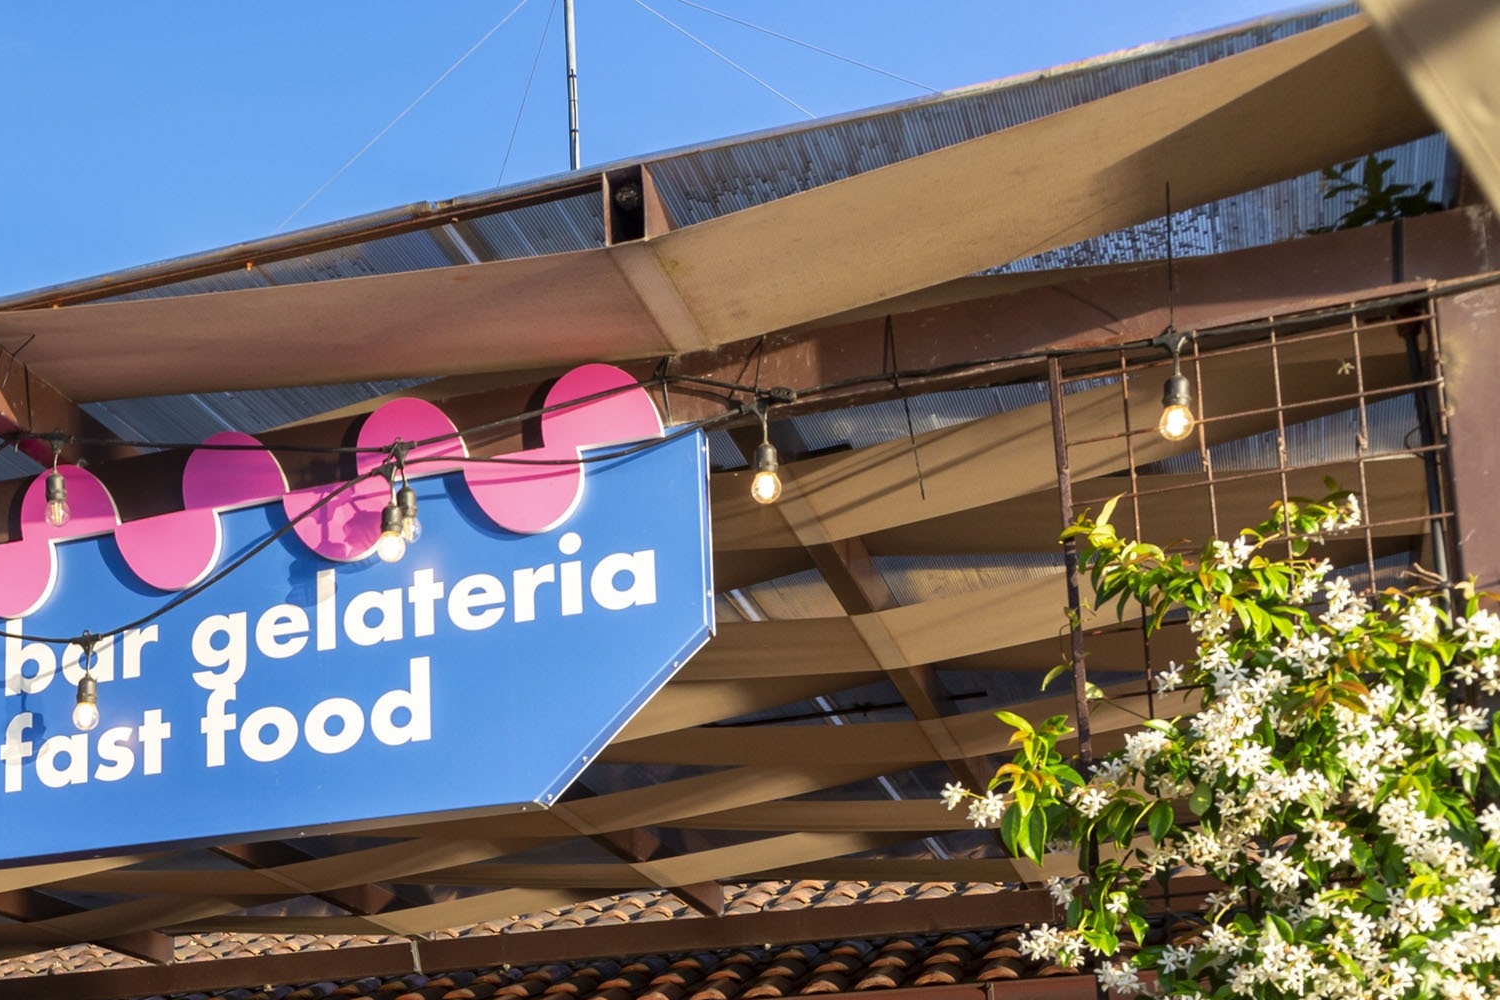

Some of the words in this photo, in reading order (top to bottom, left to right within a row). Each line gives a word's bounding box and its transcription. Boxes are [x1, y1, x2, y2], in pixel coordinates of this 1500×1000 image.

[3, 619, 159, 697] bar
[189, 533, 658, 700] gelateria
[0, 711, 171, 794] fast
[202, 656, 431, 767] food
